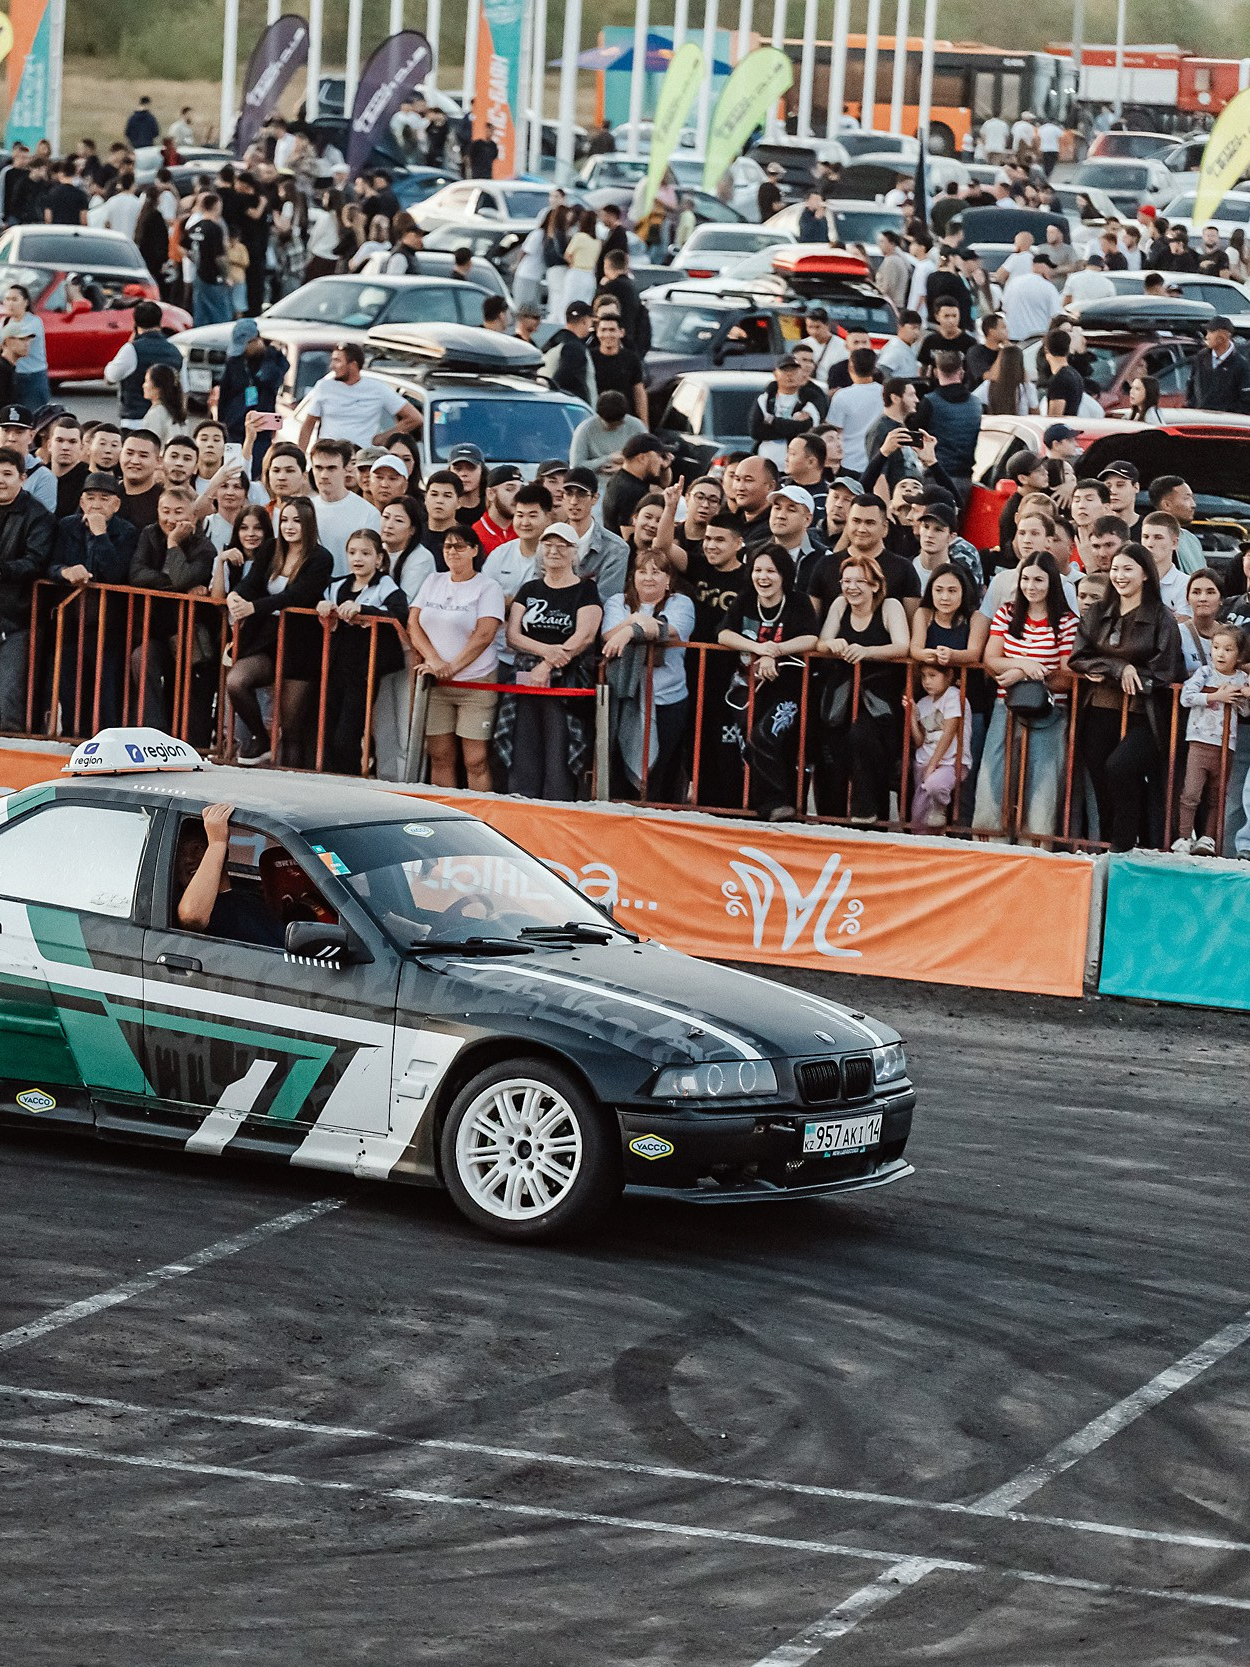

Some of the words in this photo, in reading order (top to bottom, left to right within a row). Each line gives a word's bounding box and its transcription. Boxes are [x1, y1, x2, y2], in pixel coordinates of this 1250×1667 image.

[143, 742, 187, 762] region
[74, 755, 103, 767] region
[23, 1096, 50, 1105] YACCO
[867, 1117, 881, 1142] 14
[636, 1143, 667, 1151] YACCO
[804, 1140, 815, 1151] KZ
